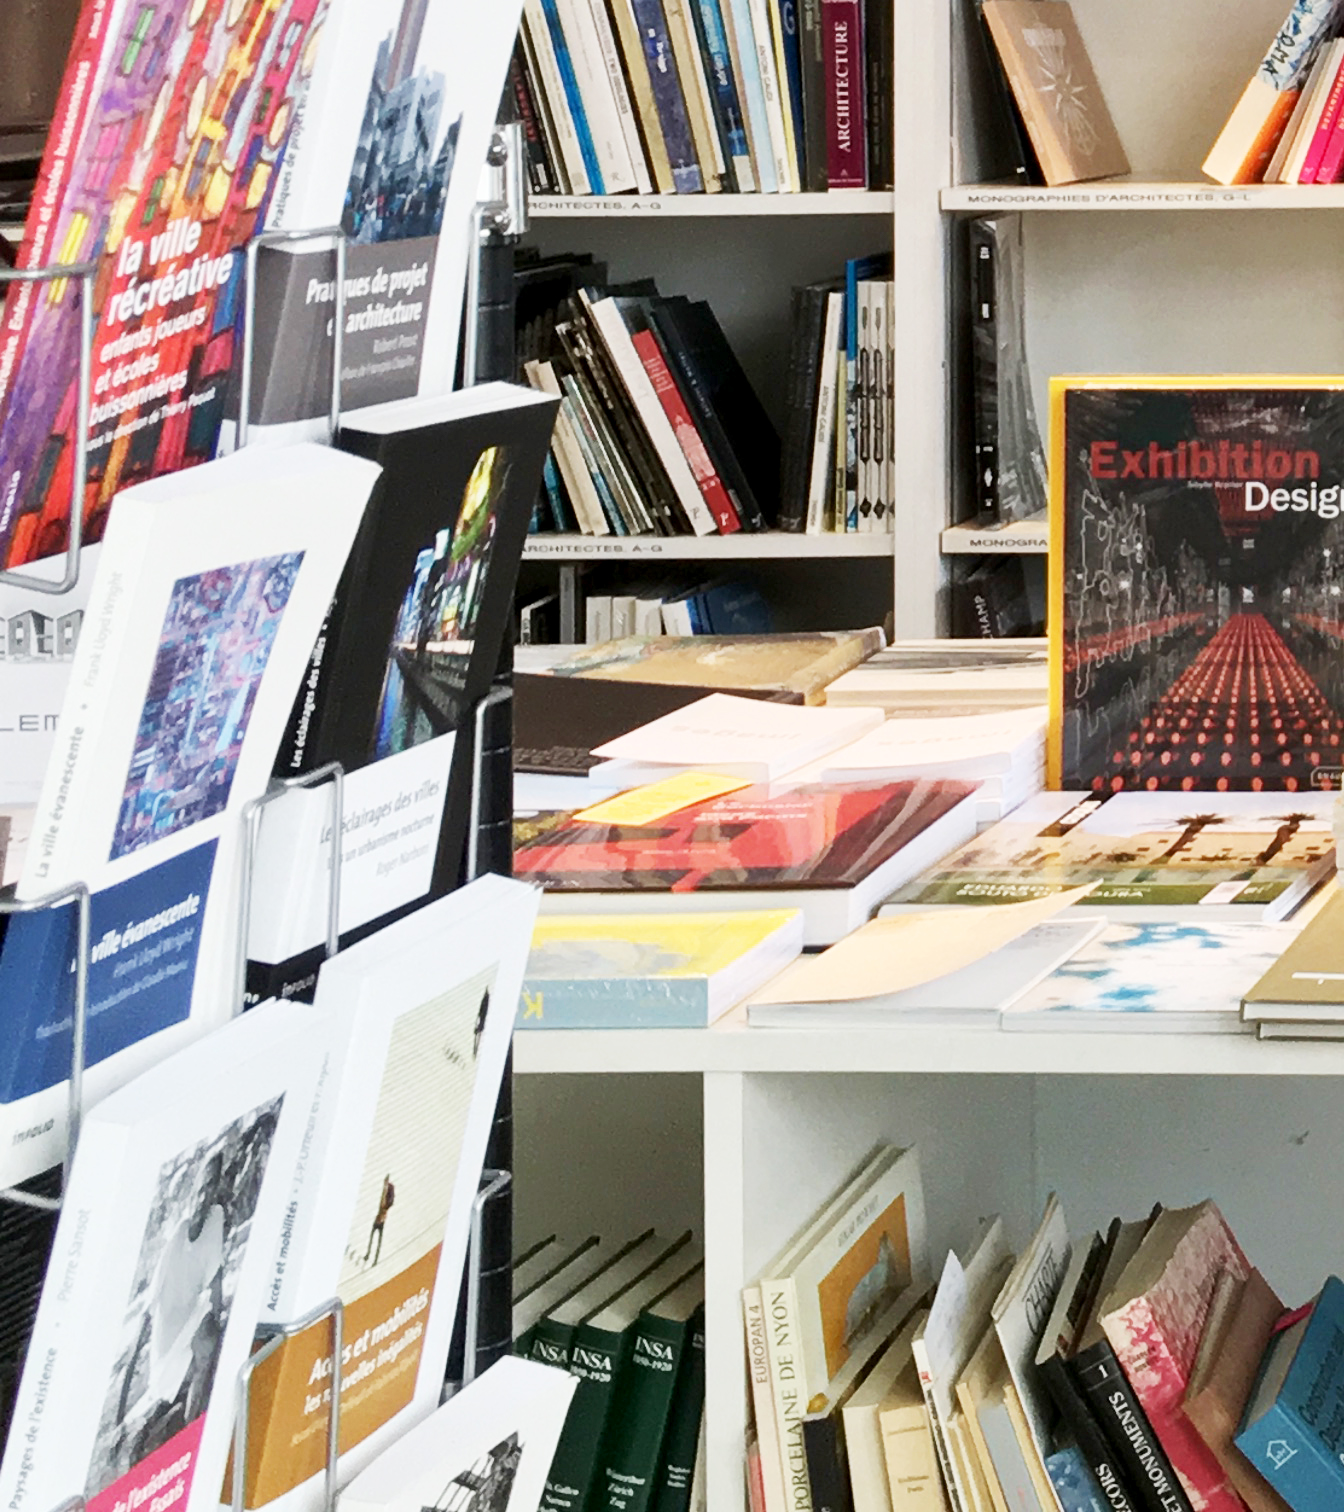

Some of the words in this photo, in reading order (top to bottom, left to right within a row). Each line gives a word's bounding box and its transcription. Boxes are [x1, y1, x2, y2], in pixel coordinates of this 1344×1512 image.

[834, 19, 852, 153] ARCHITECTURE
[116, 235, 143, 278] la
[148, 215, 202, 266] ville
[105, 252, 235, 326] récréative
[387, 262, 428, 299] projet
[100, 326, 151, 364] enfants
[150, 306, 207, 348] joueurs
[88, 369, 188, 428] buissonnières
[93, 367, 112, 396] et
[112, 352, 161, 387] écoles
[1089, 440, 1321, 479] Exhibition
[353, 1328, 371, 1358] et
[371, 1286, 430, 1346] mobilités
[634, 1335, 674, 1361] INSA
[770, 1290, 793, 1350] NYON
[531, 1339, 569, 1364] INSA
[572, 1346, 612, 1371] INSA
[750, 1320, 769, 1384] EUROPAN
[778, 1357, 798, 1381] DE
[781, 1388, 813, 1512] PORCELAINE
[1108, 1390, 1171, 1494] MONUMENTS
